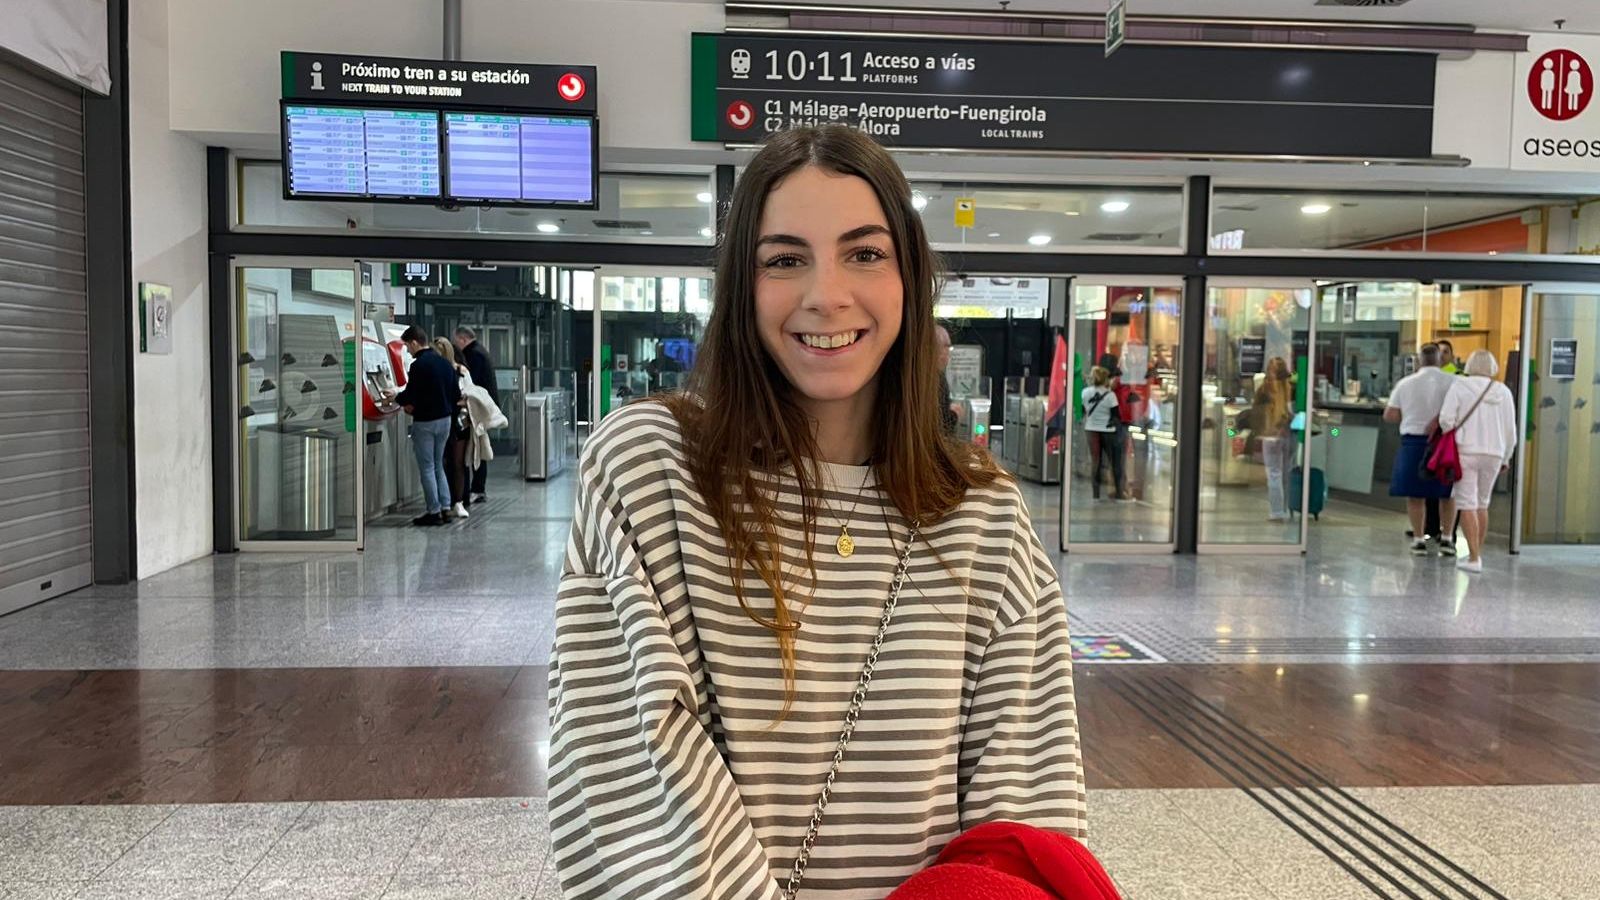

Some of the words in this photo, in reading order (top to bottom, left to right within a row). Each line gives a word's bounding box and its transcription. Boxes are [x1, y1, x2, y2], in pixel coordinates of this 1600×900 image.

[863, 52, 920, 69] Acceso
[925, 56, 935, 70] a
[941, 53, 976, 71] vías
[342, 63, 400, 79] Próximo
[404, 65, 434, 80] tren
[438, 69, 447, 81] a
[451, 70, 467, 82] su
[471, 69, 530, 85] estación
[863, 74, 918, 84] PLATFORMS
[342, 82, 363, 92] NEXT
[365, 83, 390, 94] TRAIN
[391, 84, 403, 94] TO
[404, 85, 428, 95] YOUR
[428, 86, 462, 97] STATION
[764, 100, 783, 115] C1
[764, 117, 783, 132] C2
[982, 129, 1008, 138] LOCAL
[1010, 130, 1044, 139] TRAINS
[1523, 138, 1600, 157] aseos
